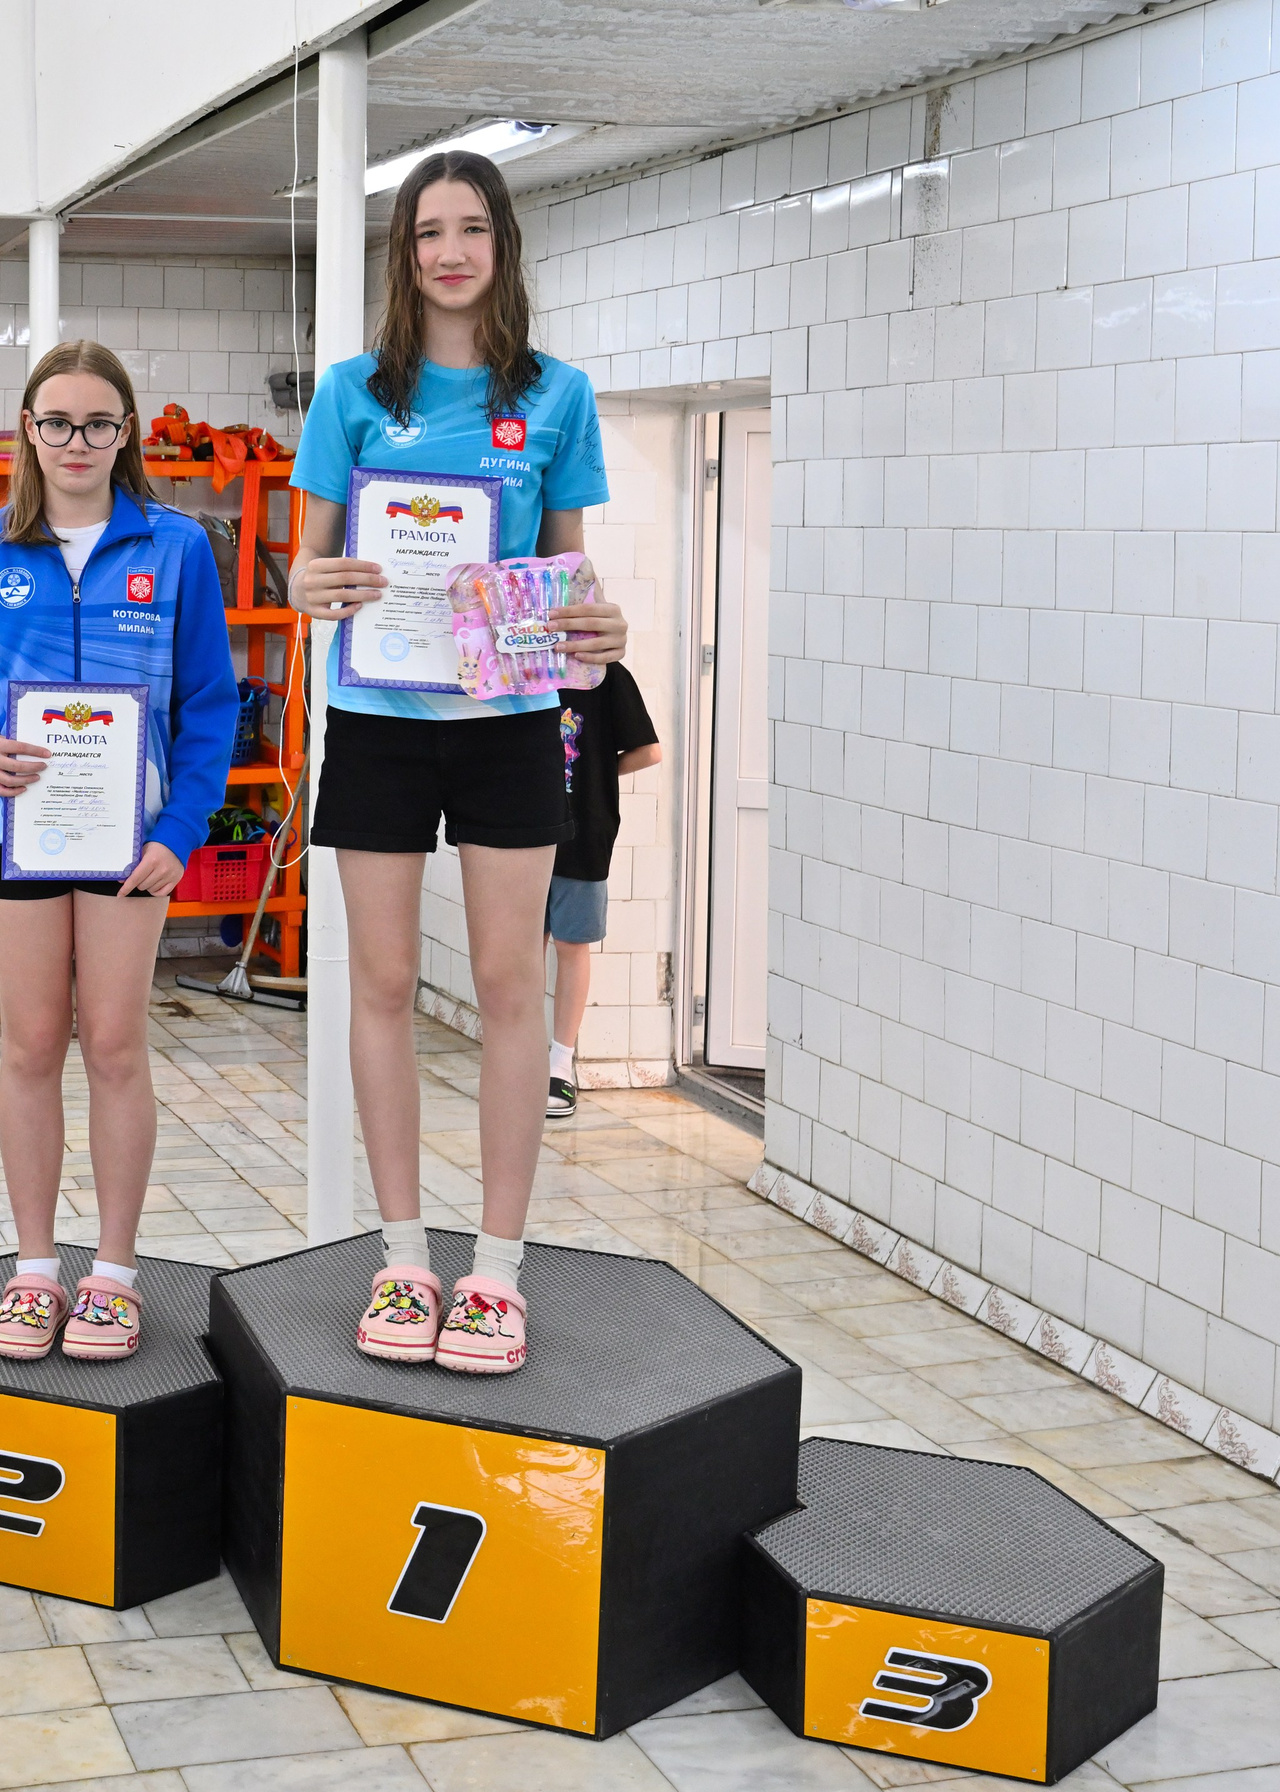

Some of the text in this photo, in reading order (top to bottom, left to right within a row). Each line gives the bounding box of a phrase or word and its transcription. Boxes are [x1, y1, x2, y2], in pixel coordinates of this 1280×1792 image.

[480, 457, 531, 472] ДУГИНА
[485, 474, 523, 488] ИНА
[391, 529, 457, 544] ГРАМОТА
[396, 548, 450, 557] НАГРАЖДАЕТСЯ
[112, 609, 161, 622] КОТОРОВА
[118, 623, 154, 635] МИЛАНА
[46, 734, 107, 745] ГРАМОТА
[506, 1342, 528, 1364] cro
[386, 1501, 487, 1624] 1
[858, 1646, 993, 1732] 3
